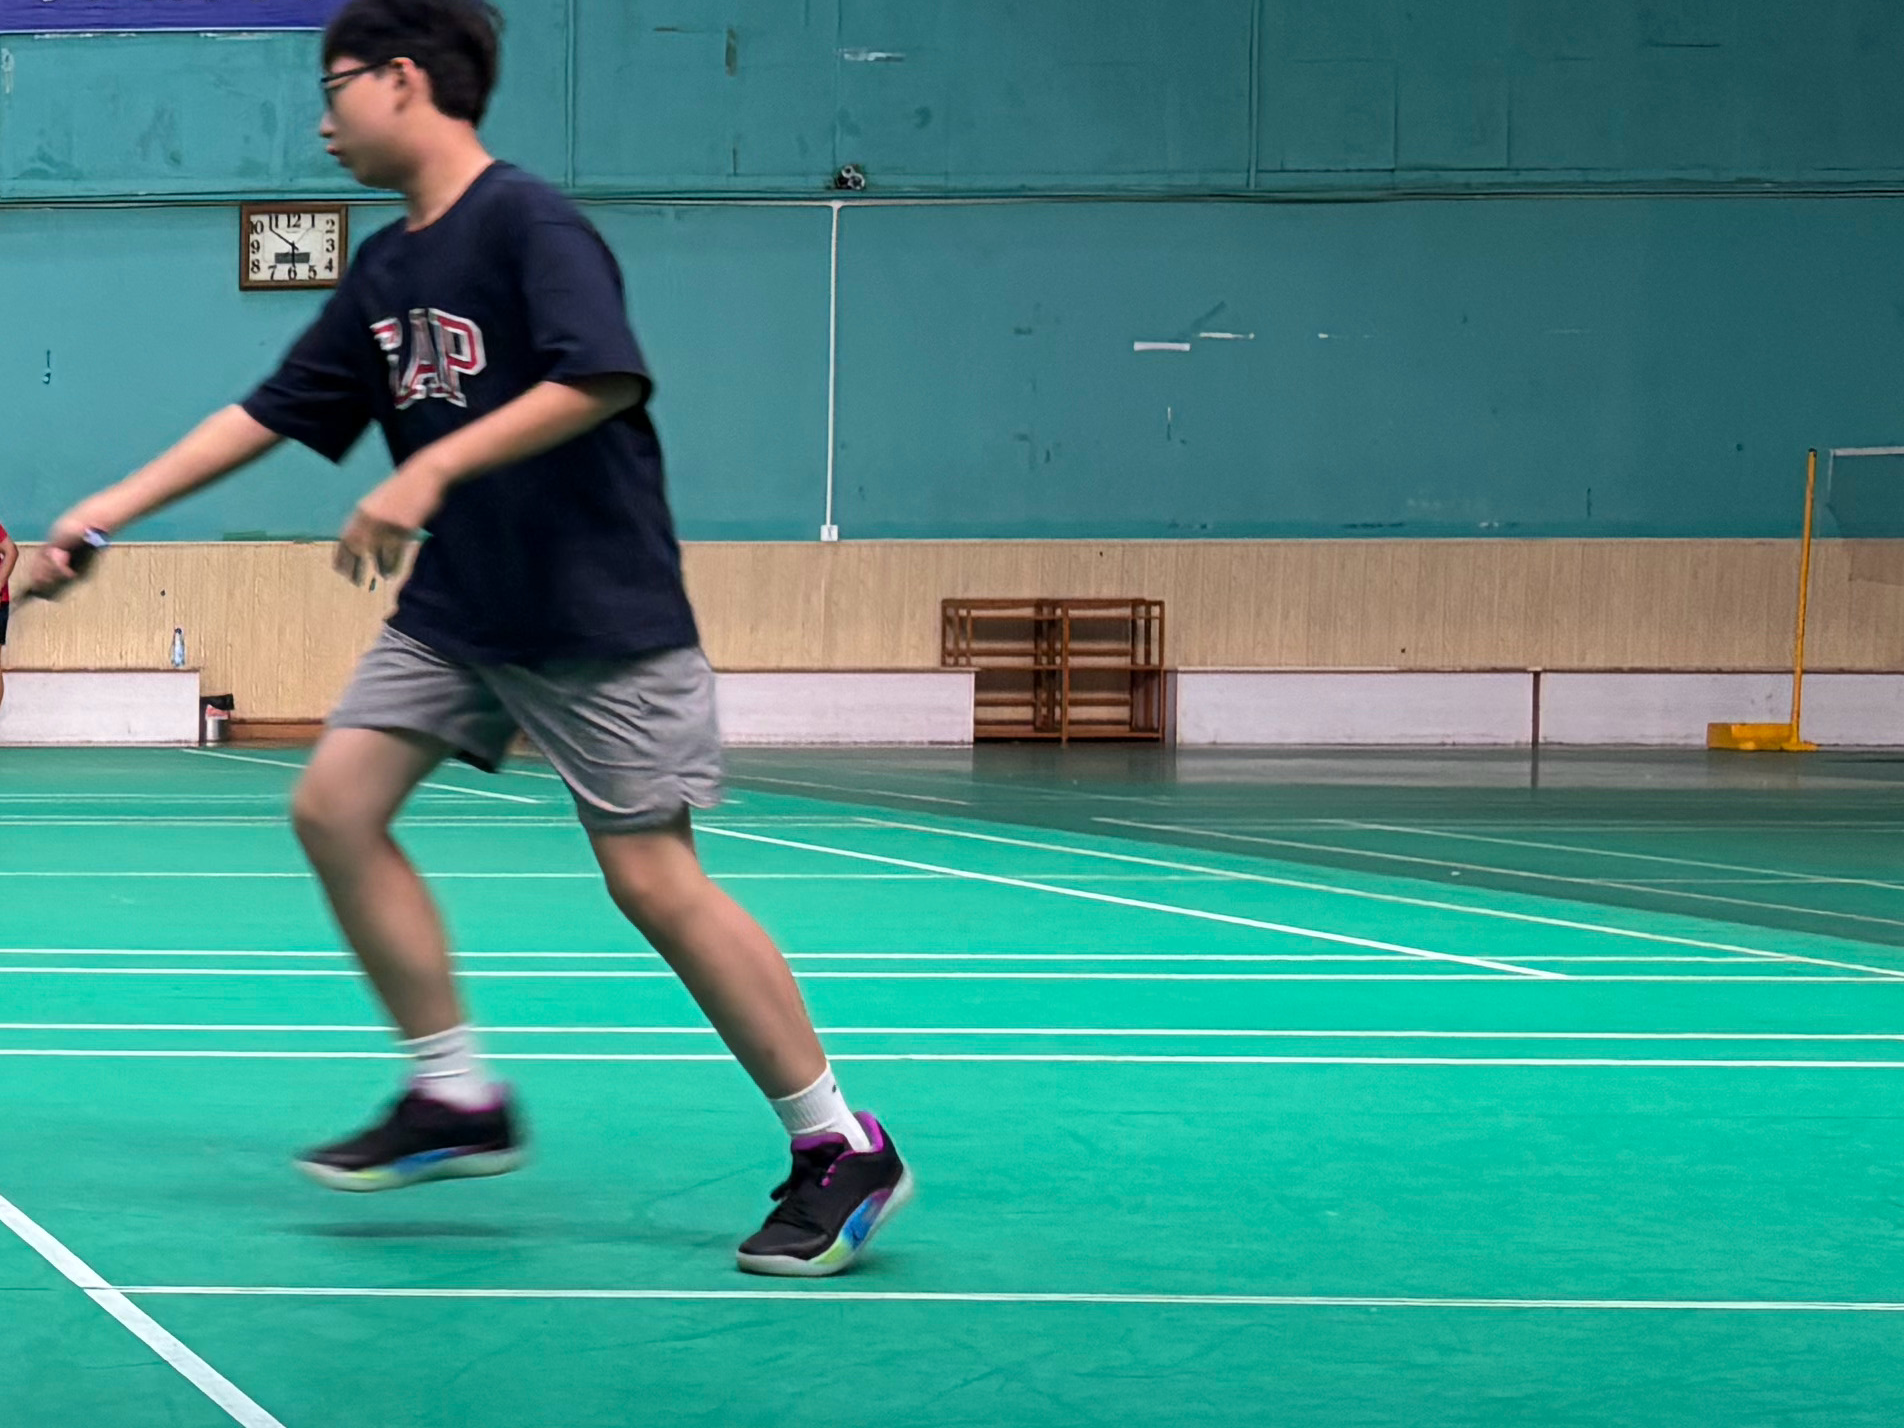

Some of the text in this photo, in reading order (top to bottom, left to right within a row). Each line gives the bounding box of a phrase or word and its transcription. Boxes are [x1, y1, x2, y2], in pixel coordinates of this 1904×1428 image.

[250, 220, 264, 235] 10
[287, 214, 302, 228] 12
[325, 219, 335, 233] 2
[251, 239, 261, 254] 9
[325, 238, 335, 253] 3
[251, 259, 261, 274] 8
[268, 265, 277, 280] 7
[288, 264, 297, 280] 6
[308, 265, 317, 280] 5
[325, 258, 333, 273] 4
